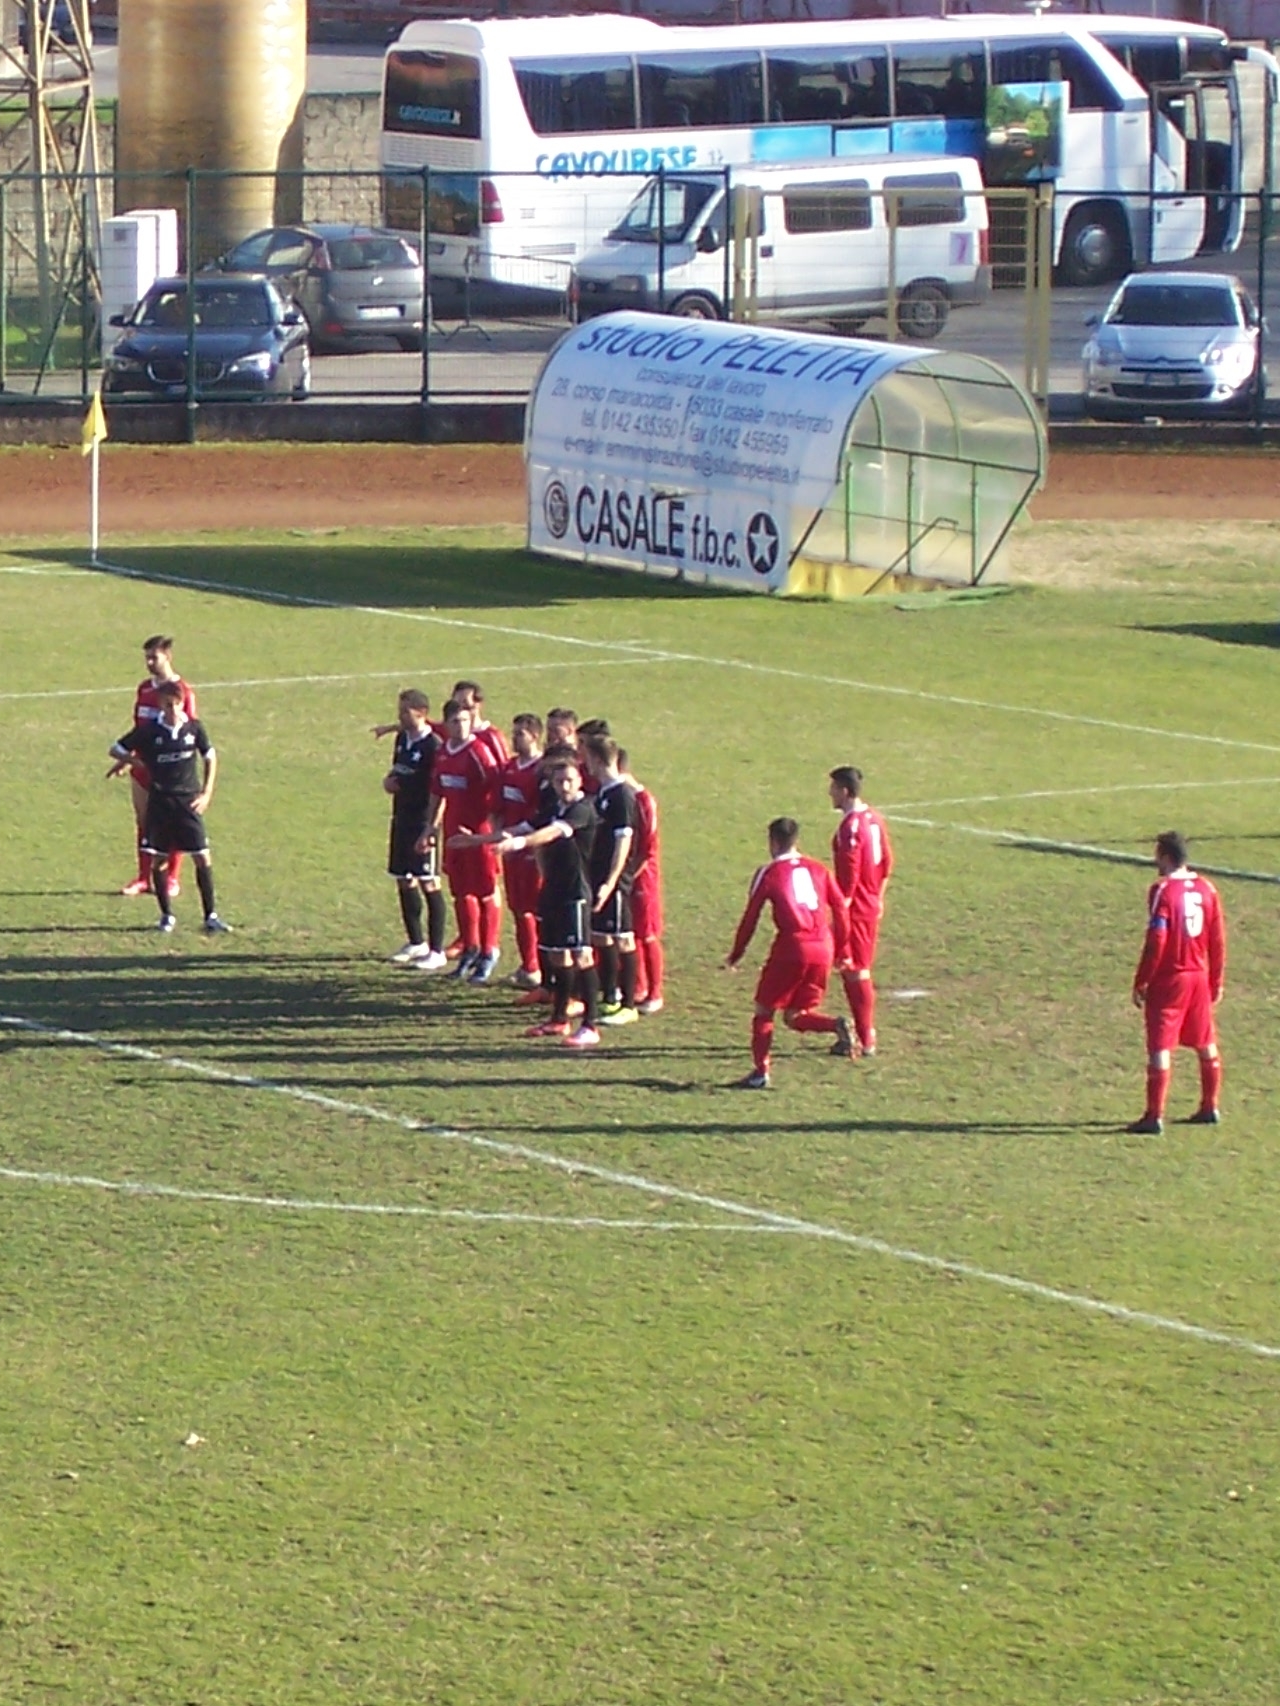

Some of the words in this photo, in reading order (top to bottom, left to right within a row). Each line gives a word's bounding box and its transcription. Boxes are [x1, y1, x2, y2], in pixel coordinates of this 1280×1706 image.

[535, 145, 697, 181] CAVOURESE
[577, 322, 704, 362] studio
[700, 331, 888, 386] PELETTA
[572, 384, 607, 402] corso
[723, 403, 764, 424] casale
[764, 408, 833, 435] monferrato
[725, 380, 767, 398] lavoro
[600, 406, 634, 434] 0142
[707, 423, 740, 450] 0142
[576, 484, 685, 559] CASALE
[691, 514, 741, 569] f.b.c.
[792, 866, 818, 911] 4
[1183, 891, 1204, 938] 5
